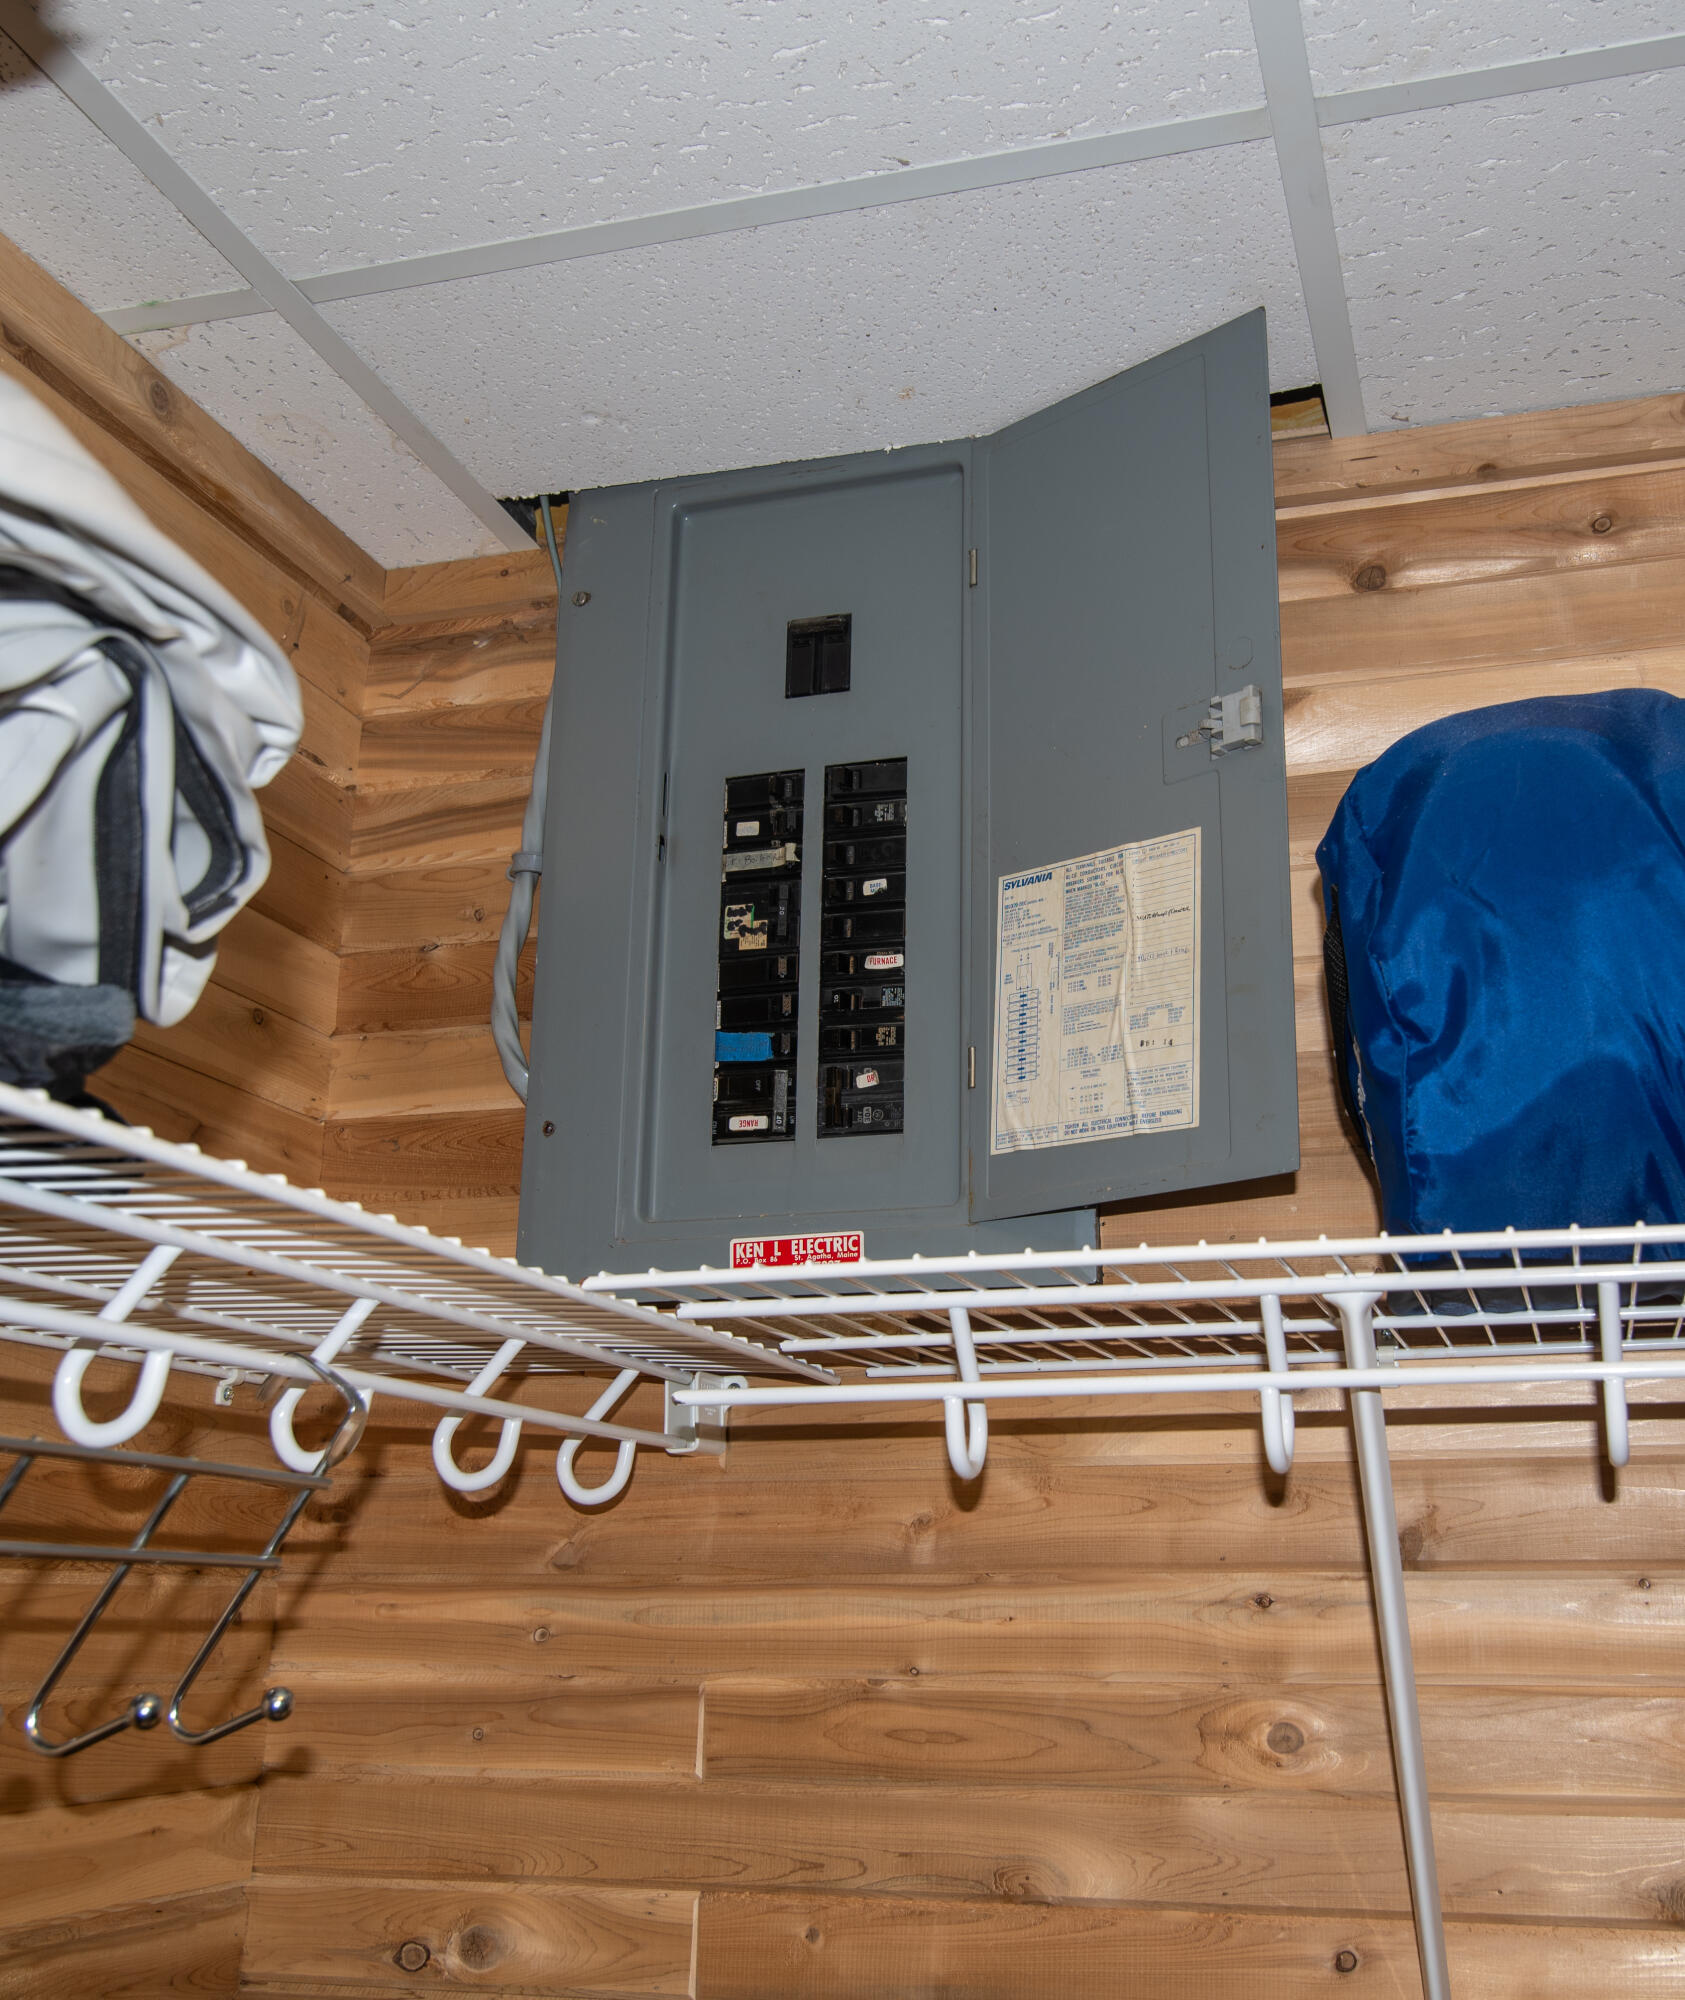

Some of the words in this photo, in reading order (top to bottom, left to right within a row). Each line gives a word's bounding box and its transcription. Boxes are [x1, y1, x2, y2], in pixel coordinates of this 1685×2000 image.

[1004, 872, 1052, 890] SYLVANIA
[869, 956, 897, 966] FURNACE
[739, 1119, 759, 1128] RANGE
[776, 1115, 782, 1125] 40
[736, 1243, 764, 1258] KEN
[774, 1241, 782, 1257] L
[792, 1236, 858, 1255] ELECTRIC
[807, 1251, 834, 1262] Agatha,
